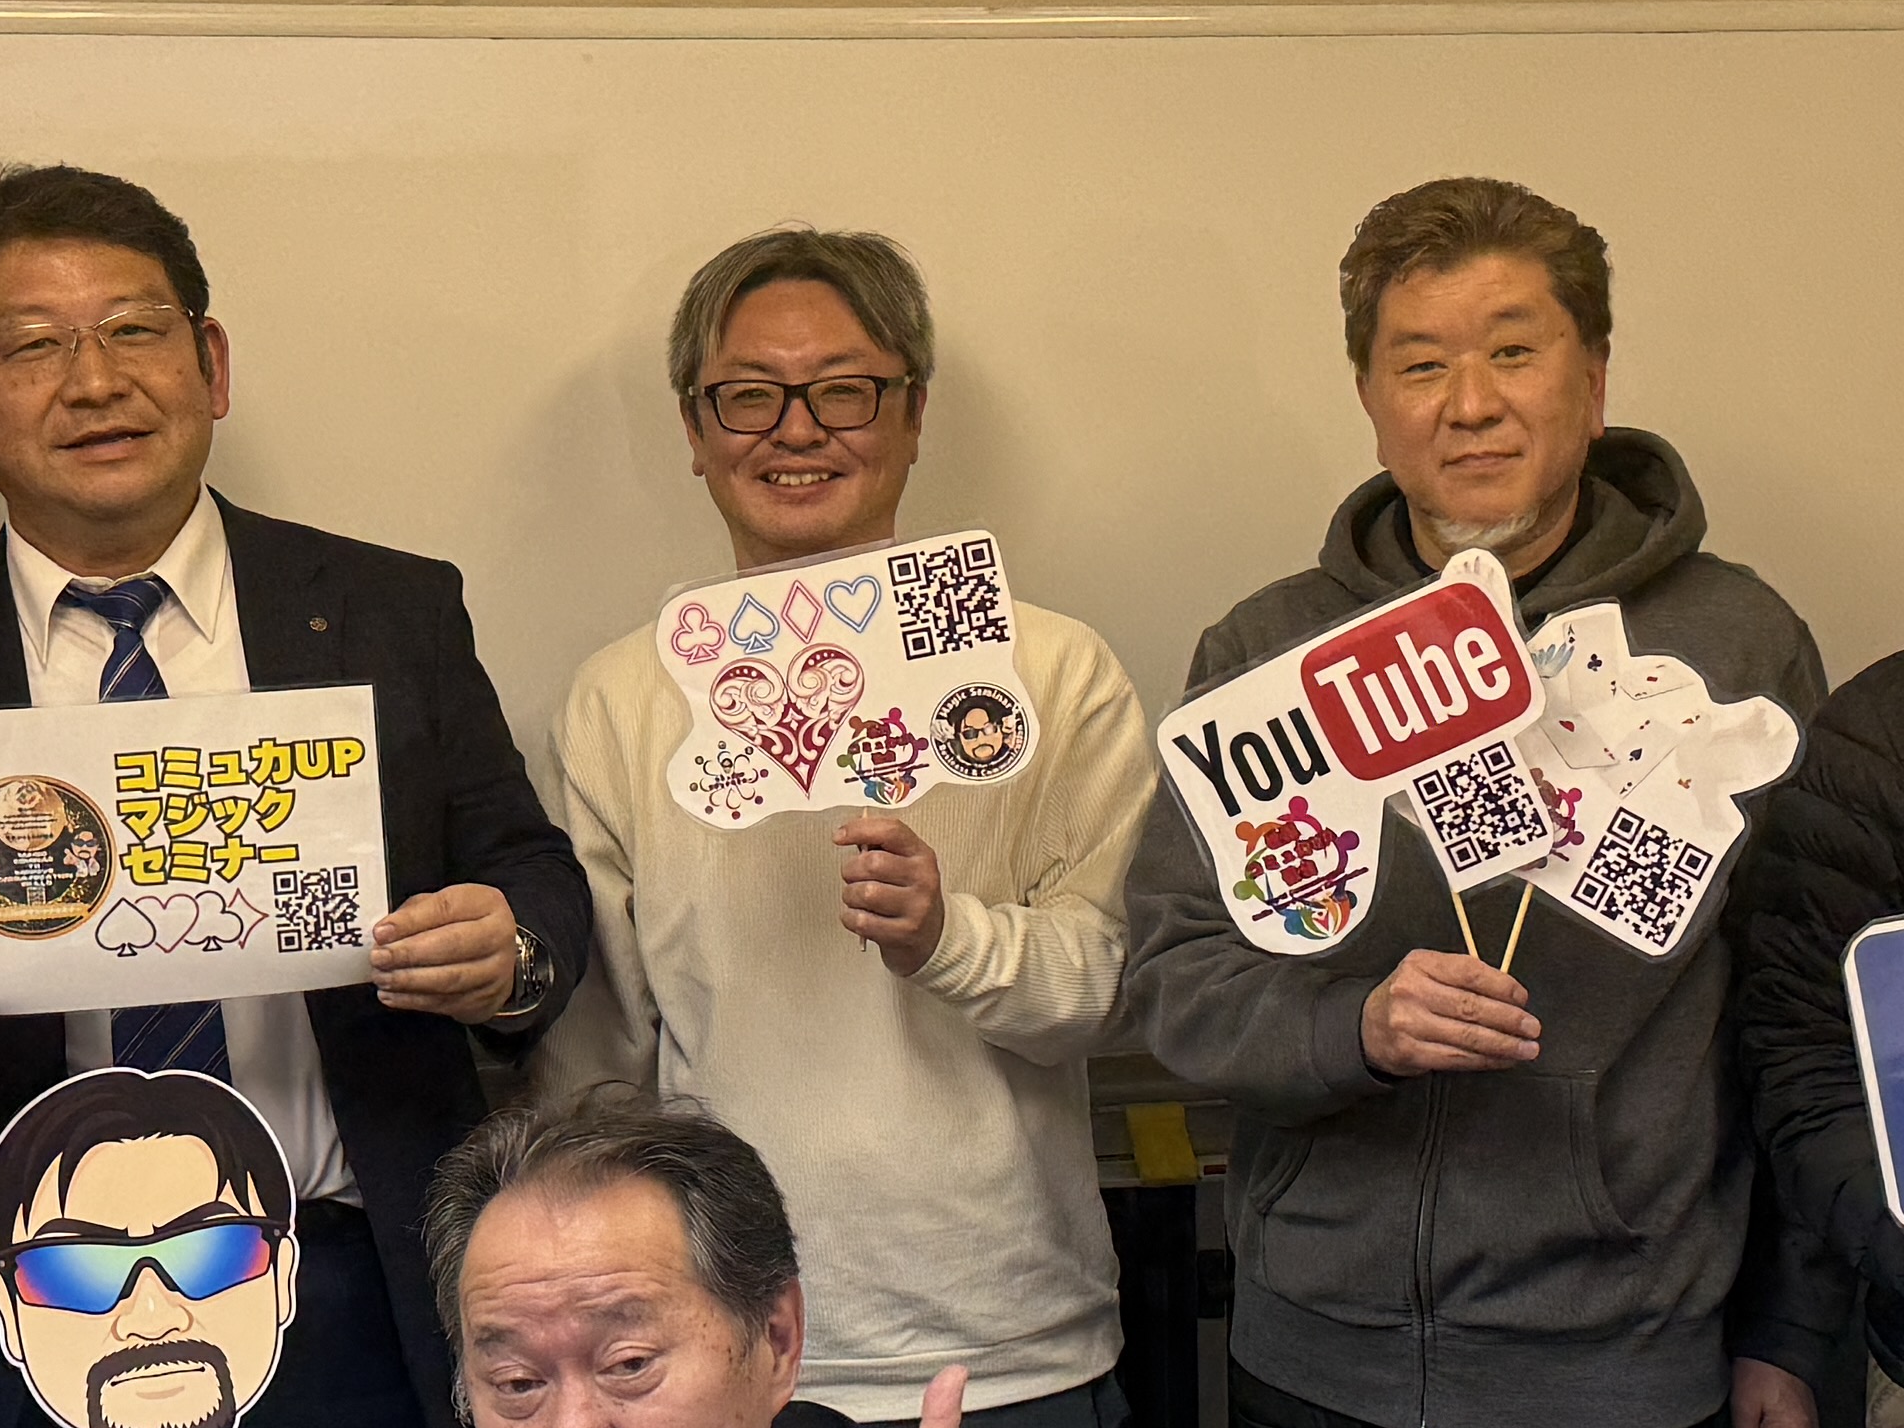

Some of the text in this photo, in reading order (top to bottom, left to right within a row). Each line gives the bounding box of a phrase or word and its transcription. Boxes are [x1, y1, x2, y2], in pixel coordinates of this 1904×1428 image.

[969, 687, 1013, 710] Seminar
[1171, 625, 1512, 818] YouTube
[114, 737, 366, 793] コミュ力UP
[116, 785, 296, 842] マジック
[118, 834, 300, 886] セミナー
